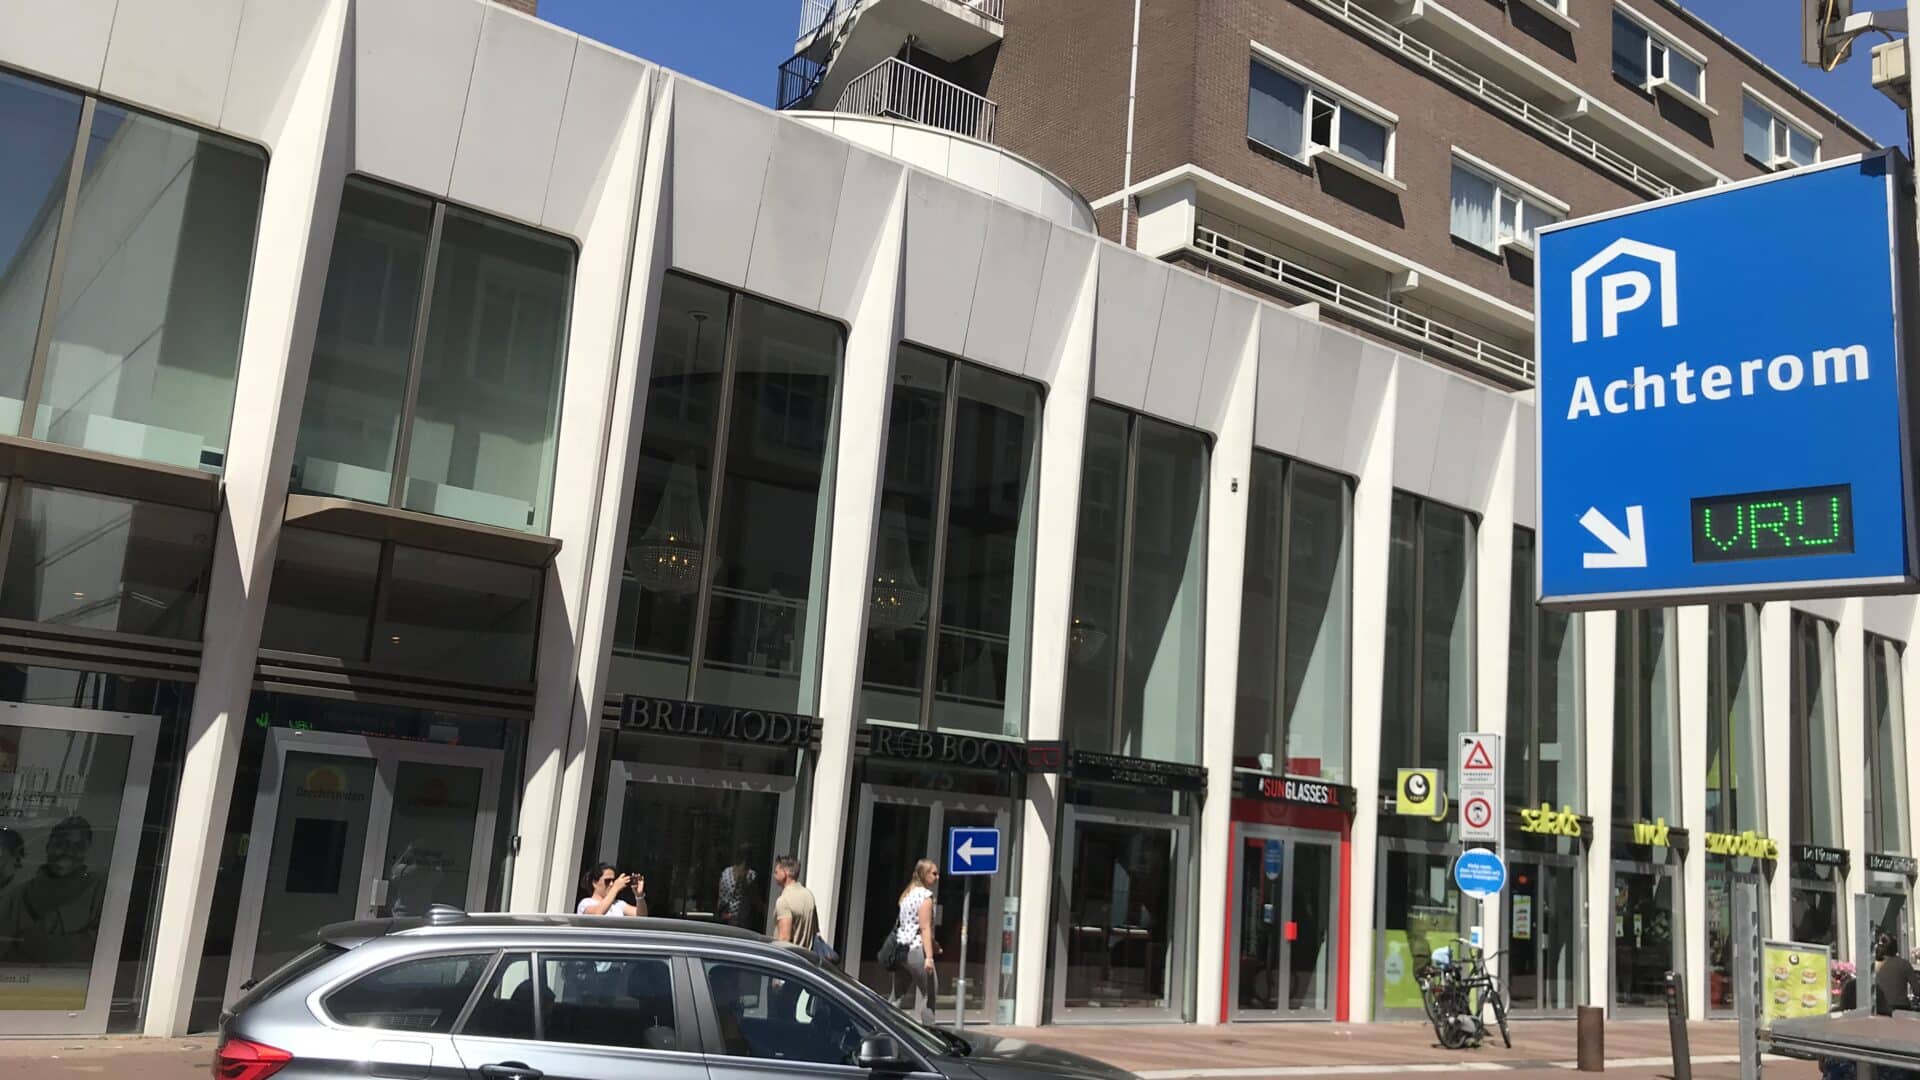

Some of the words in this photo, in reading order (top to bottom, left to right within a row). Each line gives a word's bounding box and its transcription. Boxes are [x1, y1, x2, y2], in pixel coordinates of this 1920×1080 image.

[1601, 269, 1652, 338] P
[1566, 343, 1870, 421] Achterom
[877, 726, 934, 759] ROB
[939, 734, 1027, 772] BOON
[1519, 802, 1582, 838] salads
